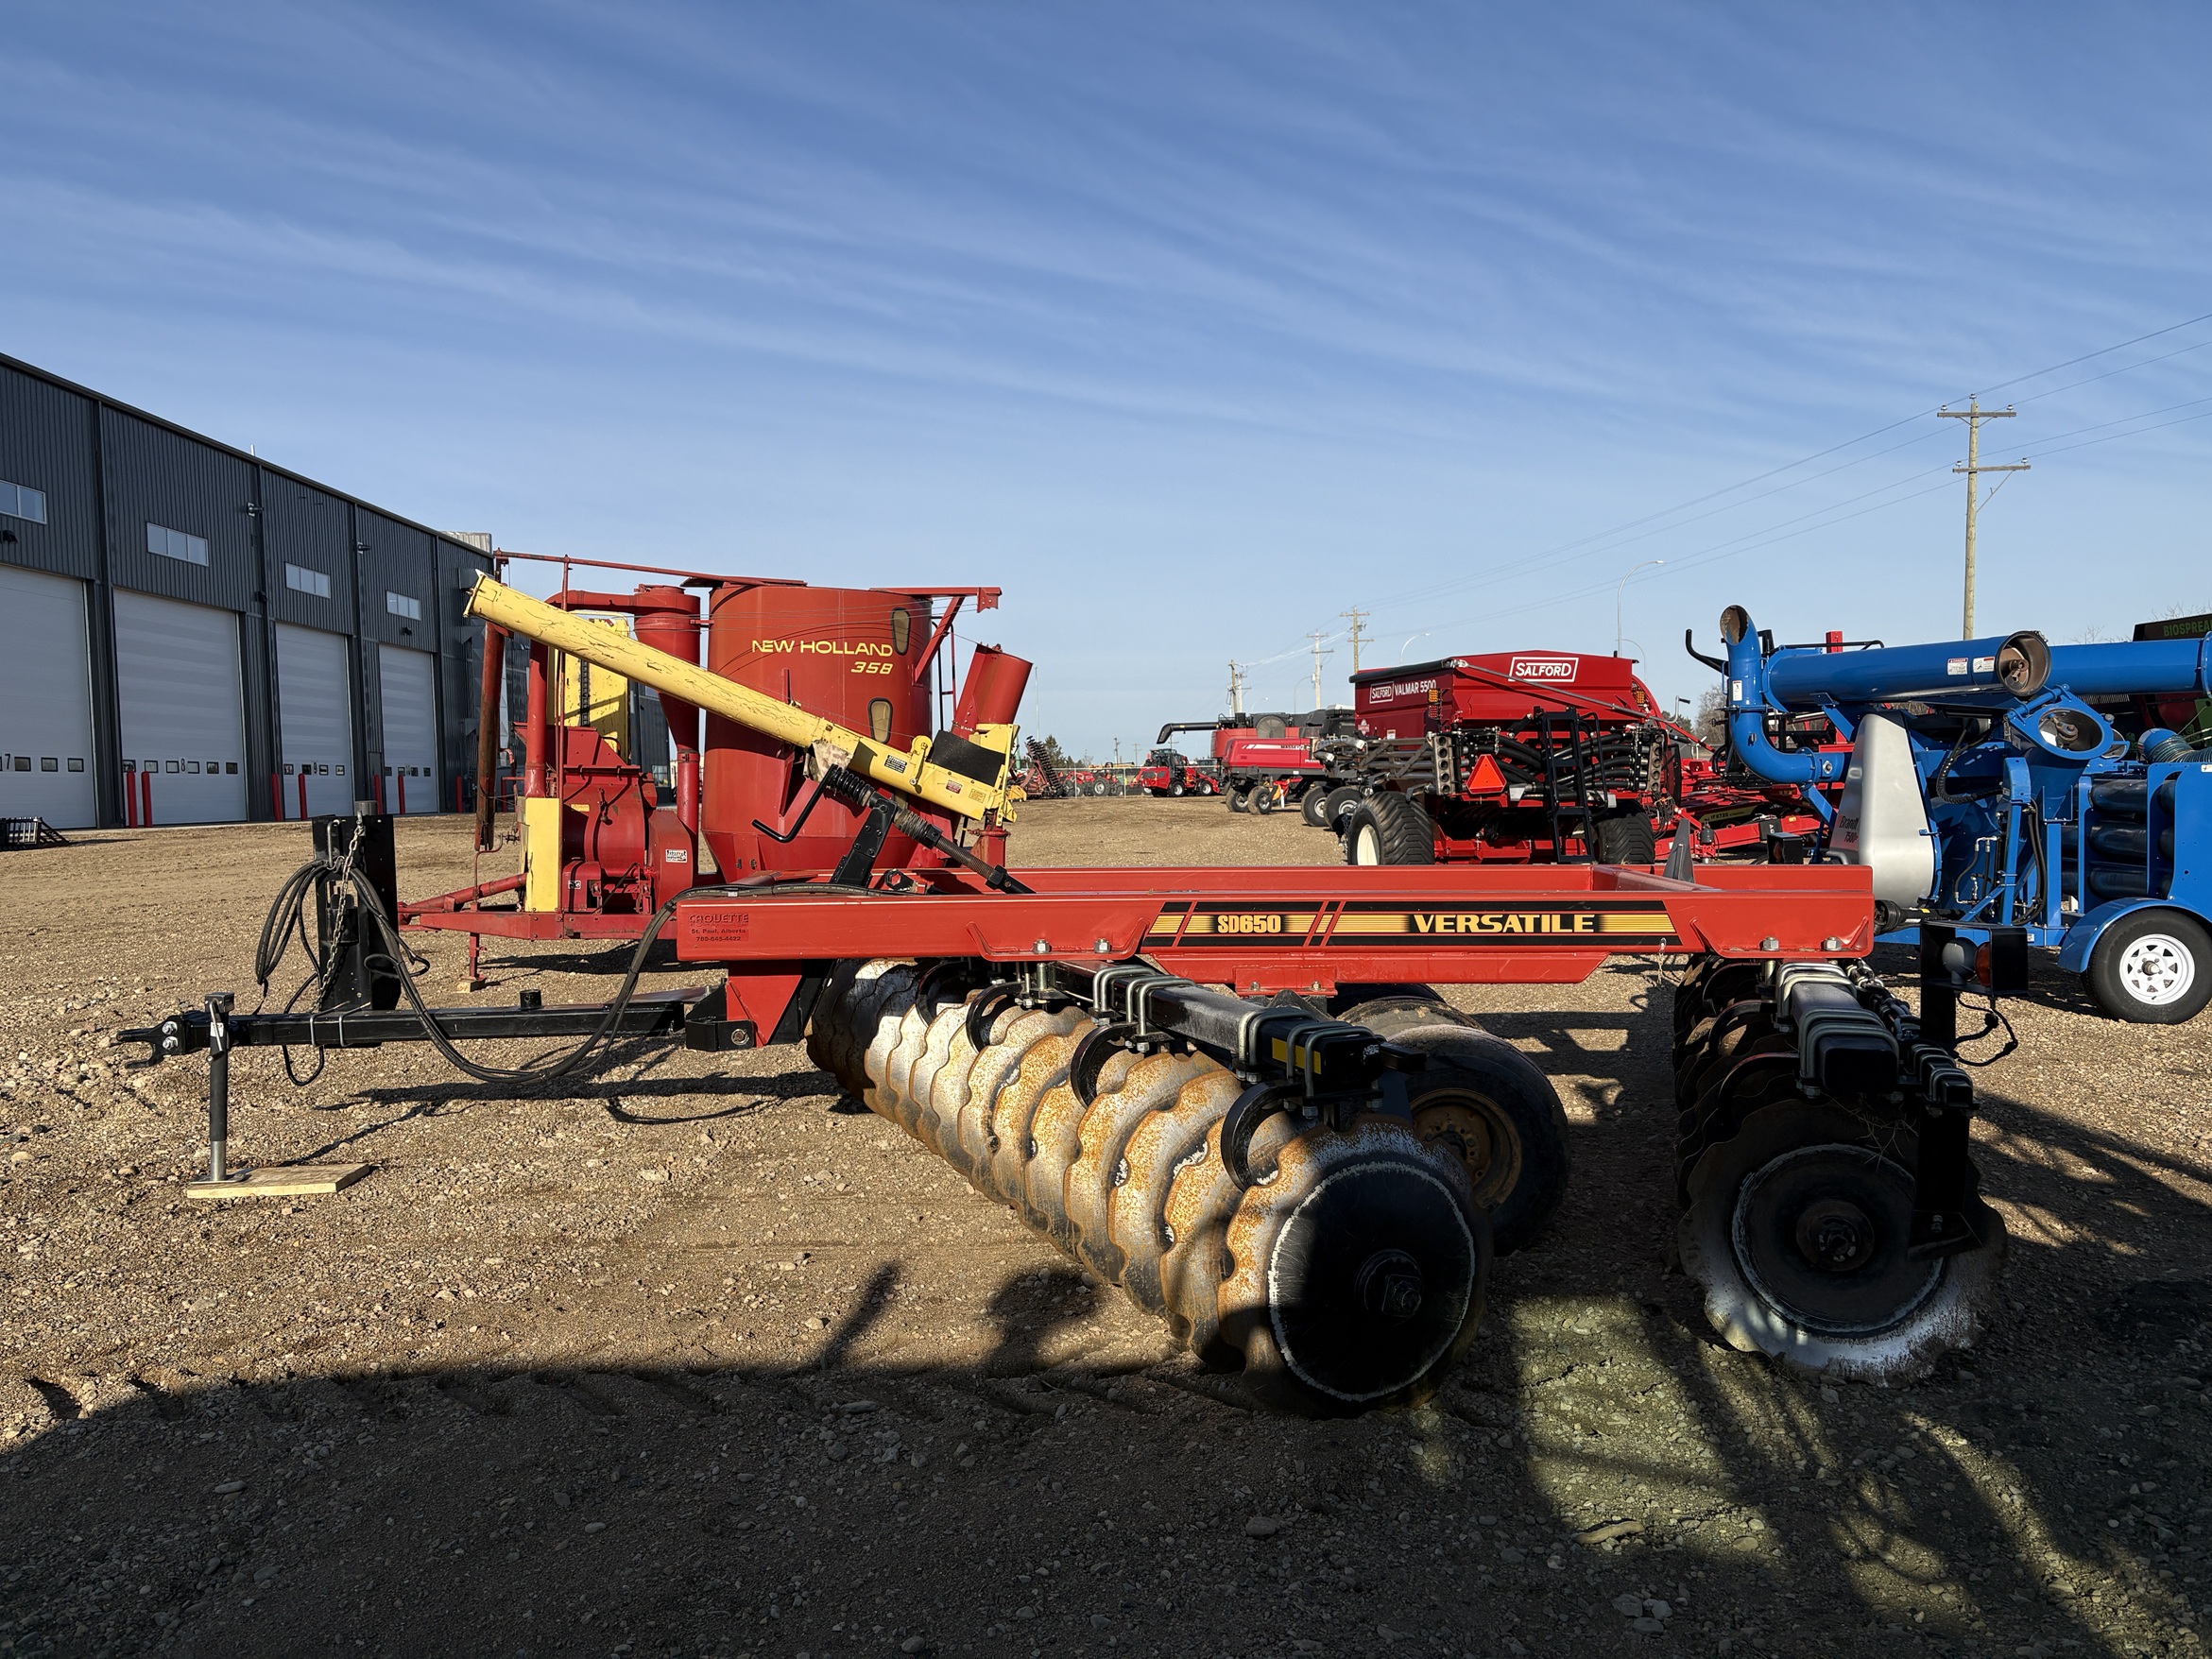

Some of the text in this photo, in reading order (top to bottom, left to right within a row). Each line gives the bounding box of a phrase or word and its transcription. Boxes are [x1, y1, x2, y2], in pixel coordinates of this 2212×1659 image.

[2163, 620, 2212, 637] BIOSPREA
[752, 640, 893, 657] NEW HOLLAND
[851, 661, 893, 675] 358
[1515, 662, 1572, 676] SALFORD
[1372, 679, 1436, 699] SALFORD VALMAR 5500
[5, 753, 10, 770] 7
[180, 758, 186, 772] 8
[314, 762, 317, 774] 9
[1839, 815, 1860, 830] Brandt
[1217, 914, 1595, 933] SD650 VERSATILE
